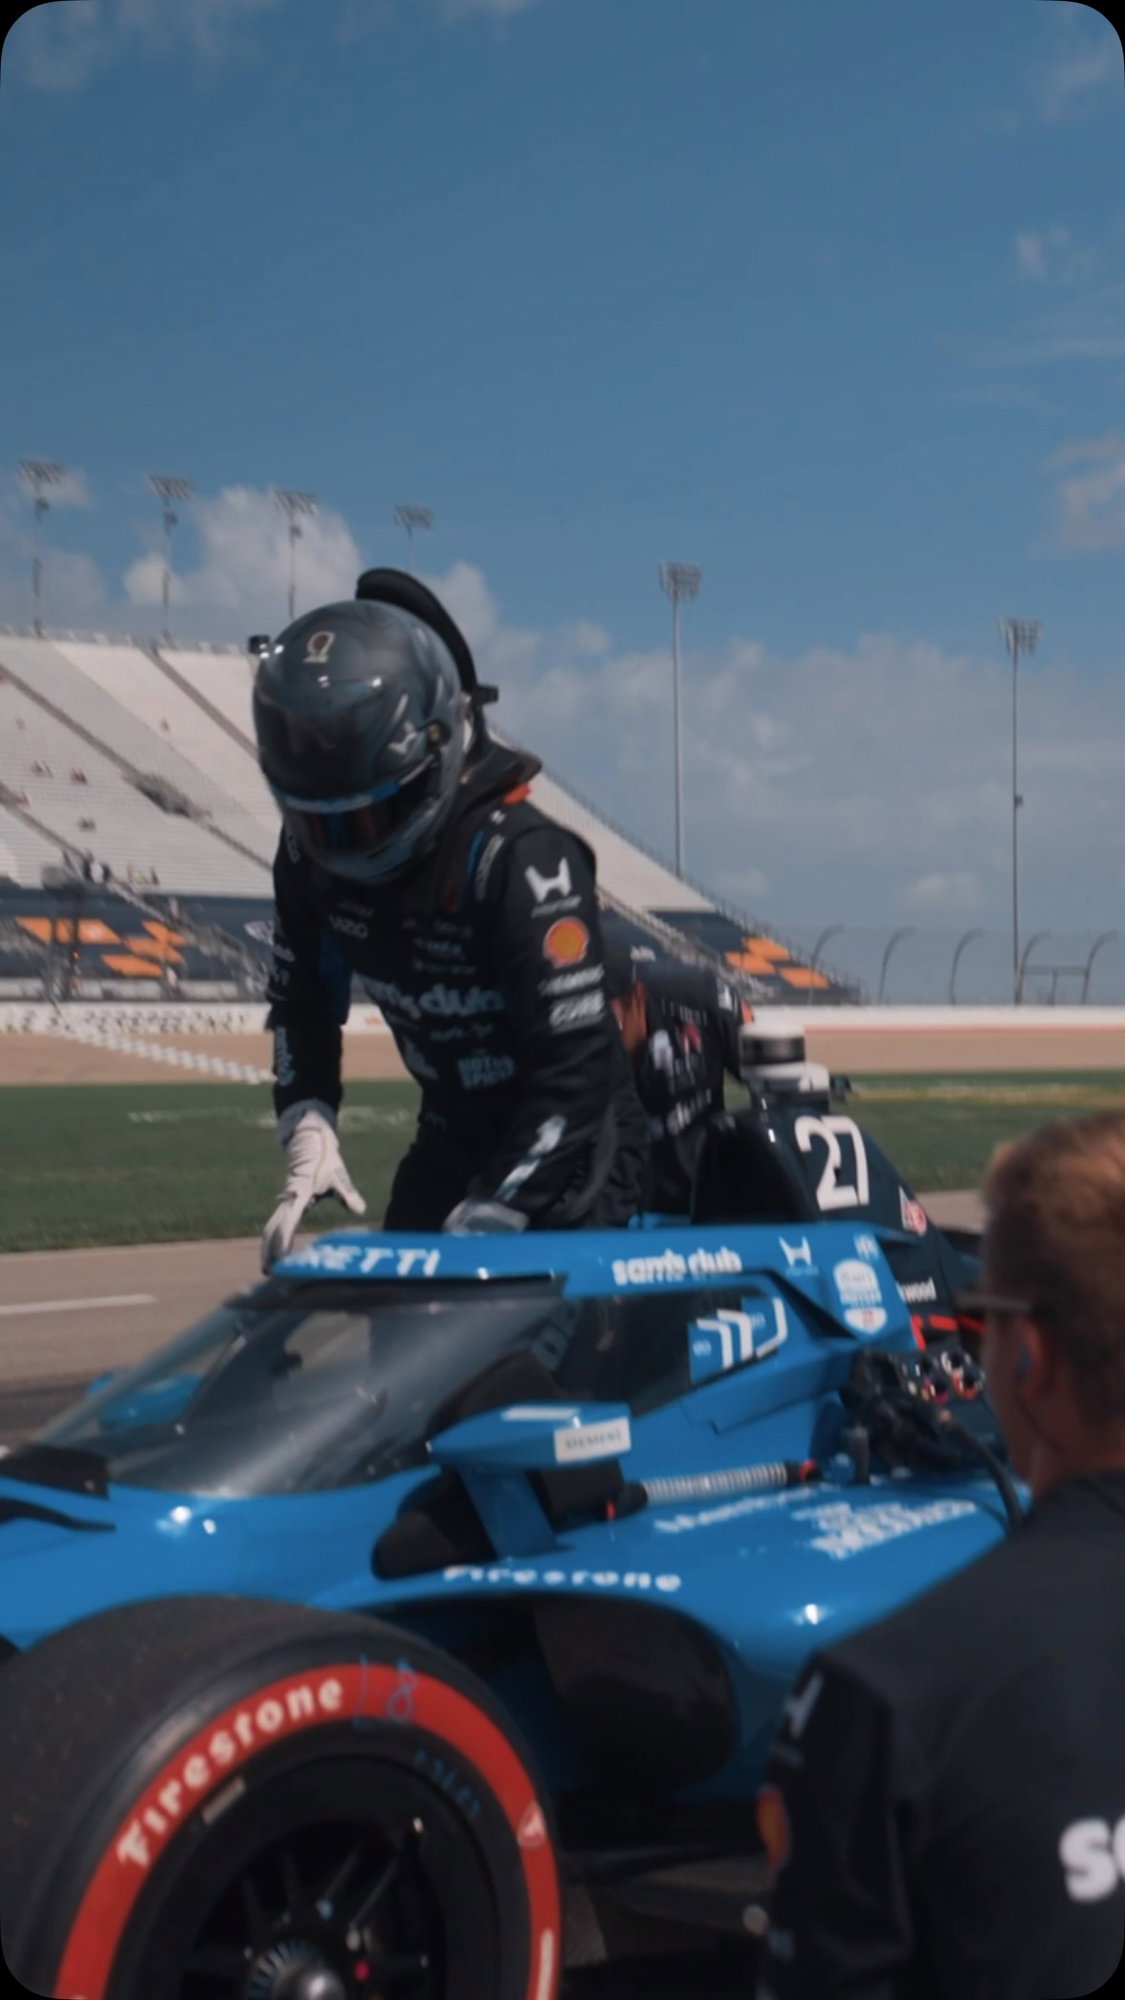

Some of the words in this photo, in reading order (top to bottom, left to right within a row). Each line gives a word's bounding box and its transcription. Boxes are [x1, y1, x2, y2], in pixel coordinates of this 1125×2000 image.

[795, 1115, 870, 1211] 27
[897, 1276, 937, 1304] wood
[115, 1677, 343, 1870] Firestone
